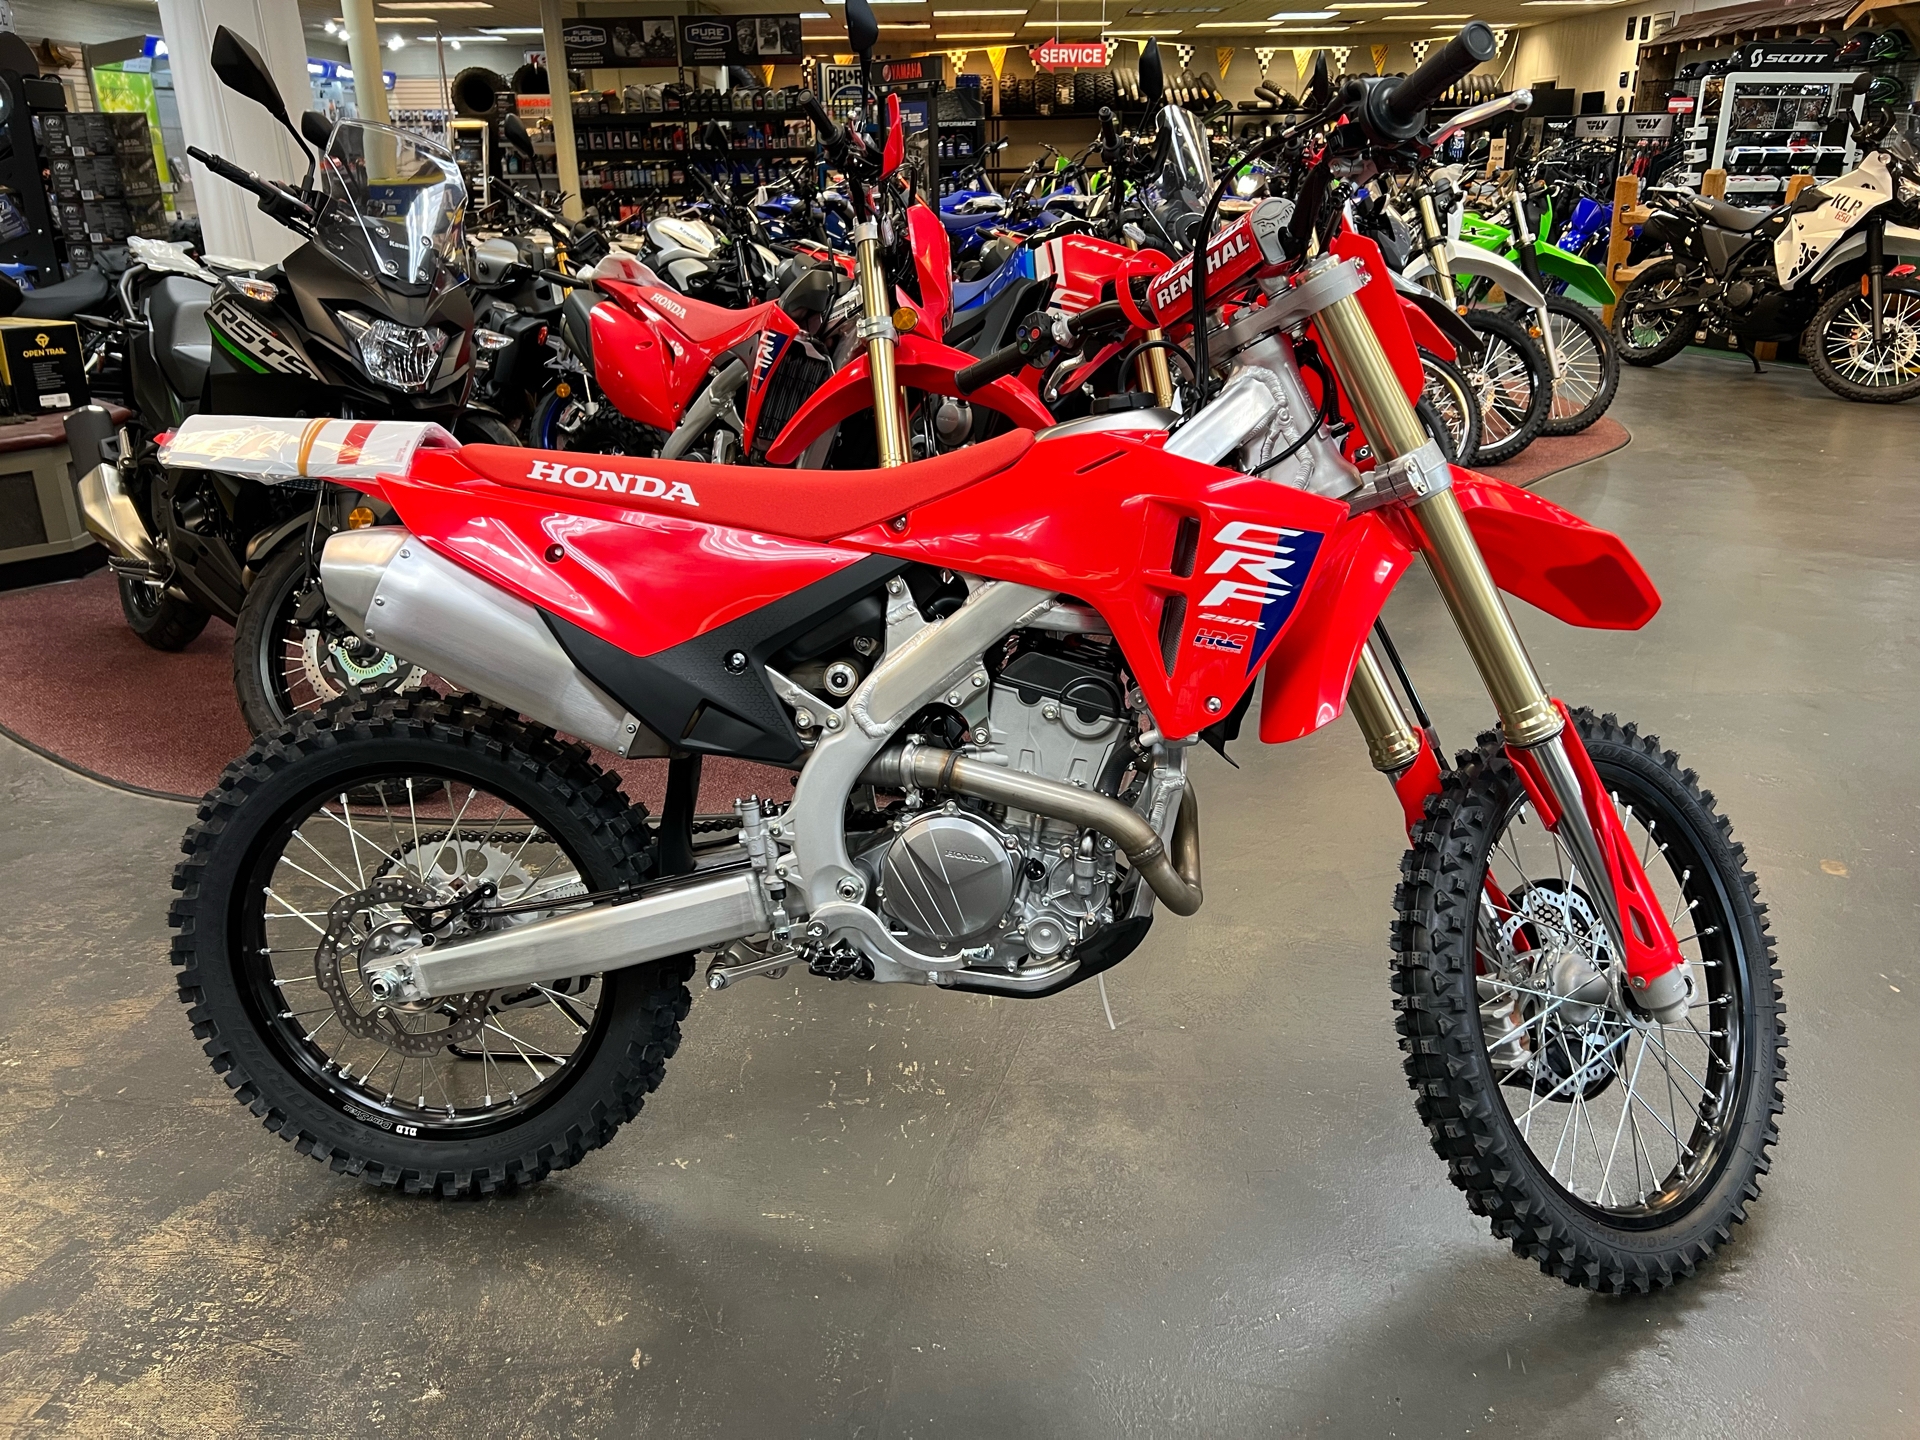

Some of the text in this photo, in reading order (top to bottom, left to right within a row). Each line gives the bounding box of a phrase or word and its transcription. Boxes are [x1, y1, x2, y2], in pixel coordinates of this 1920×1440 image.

[691, 28, 725, 36] PURE
[1040, 48, 1102, 63] SERVICE
[1763, 54, 1829, 63] SCOTT
[891, 62, 922, 79] YAMAHA
[1586, 120, 1608, 130] FLY
[1635, 119, 1661, 129] FLY
[1830, 193, 1862, 216] KLR
[1834, 211, 1852, 224] 650
[1156, 234, 1250, 310] RENHAL
[650, 292, 687, 319] HONDA
[22, 347, 67, 358] OPEN TRAIL
[526, 460, 700, 507] HONDA
[1198, 521, 1304, 607] CRF
[1198, 612, 1266, 630] 250R
[1194, 627, 1249, 650] HRC
[944, 849, 990, 864] HONDA
